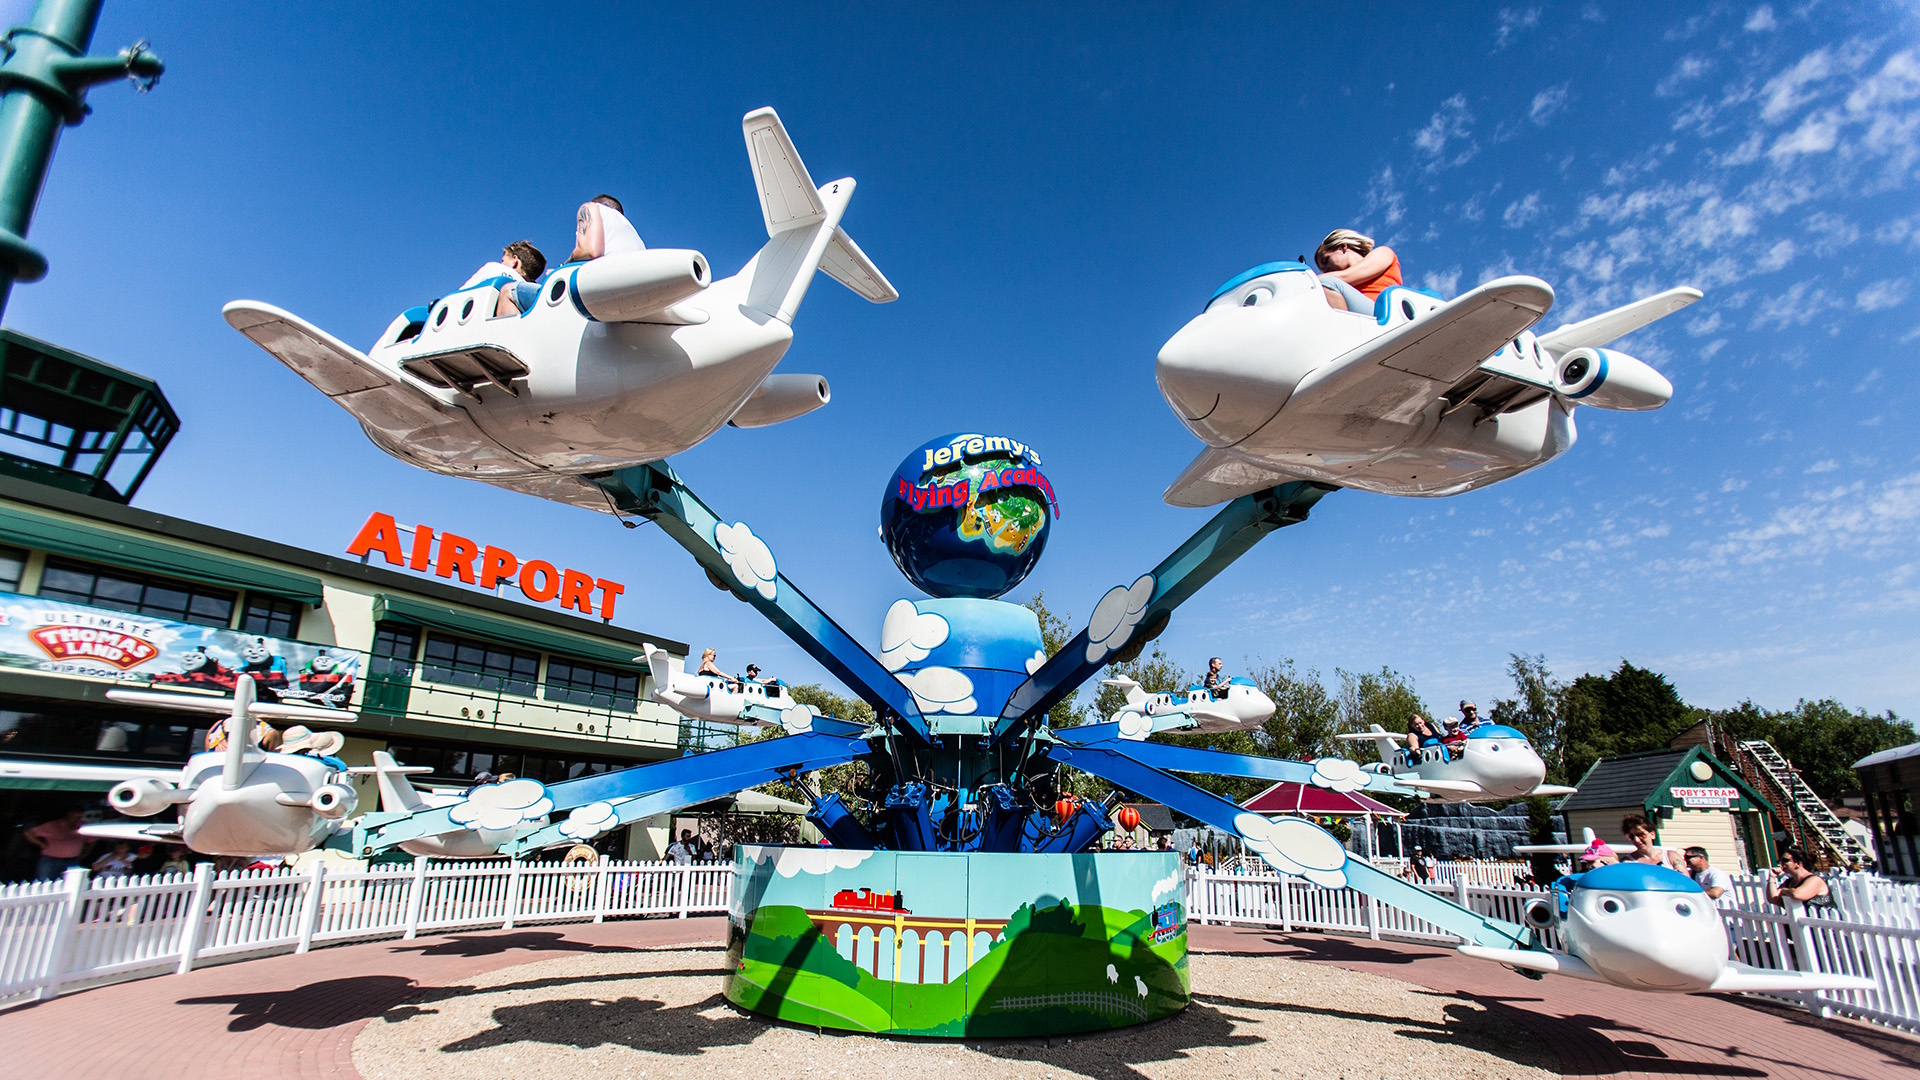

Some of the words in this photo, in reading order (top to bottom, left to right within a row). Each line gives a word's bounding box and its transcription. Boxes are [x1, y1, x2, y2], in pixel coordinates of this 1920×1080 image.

[832, 184, 839, 194] 2
[922, 435, 1043, 471] Jeremy's
[898, 476, 971, 511] Flying
[345, 511, 625, 620] AIRPORT
[45, 613, 153, 638] ULTIMATE
[38, 627, 151, 659] THOMAS
[65, 641, 124, 661] LAND
[52, 663, 75, 674] VIP
[78, 667, 127, 680] ROOMS
[1673, 789, 1707, 797] TOBY'S
[1707, 789, 1737, 797] TRAM
[1687, 797, 1722, 805] EXPRESS
